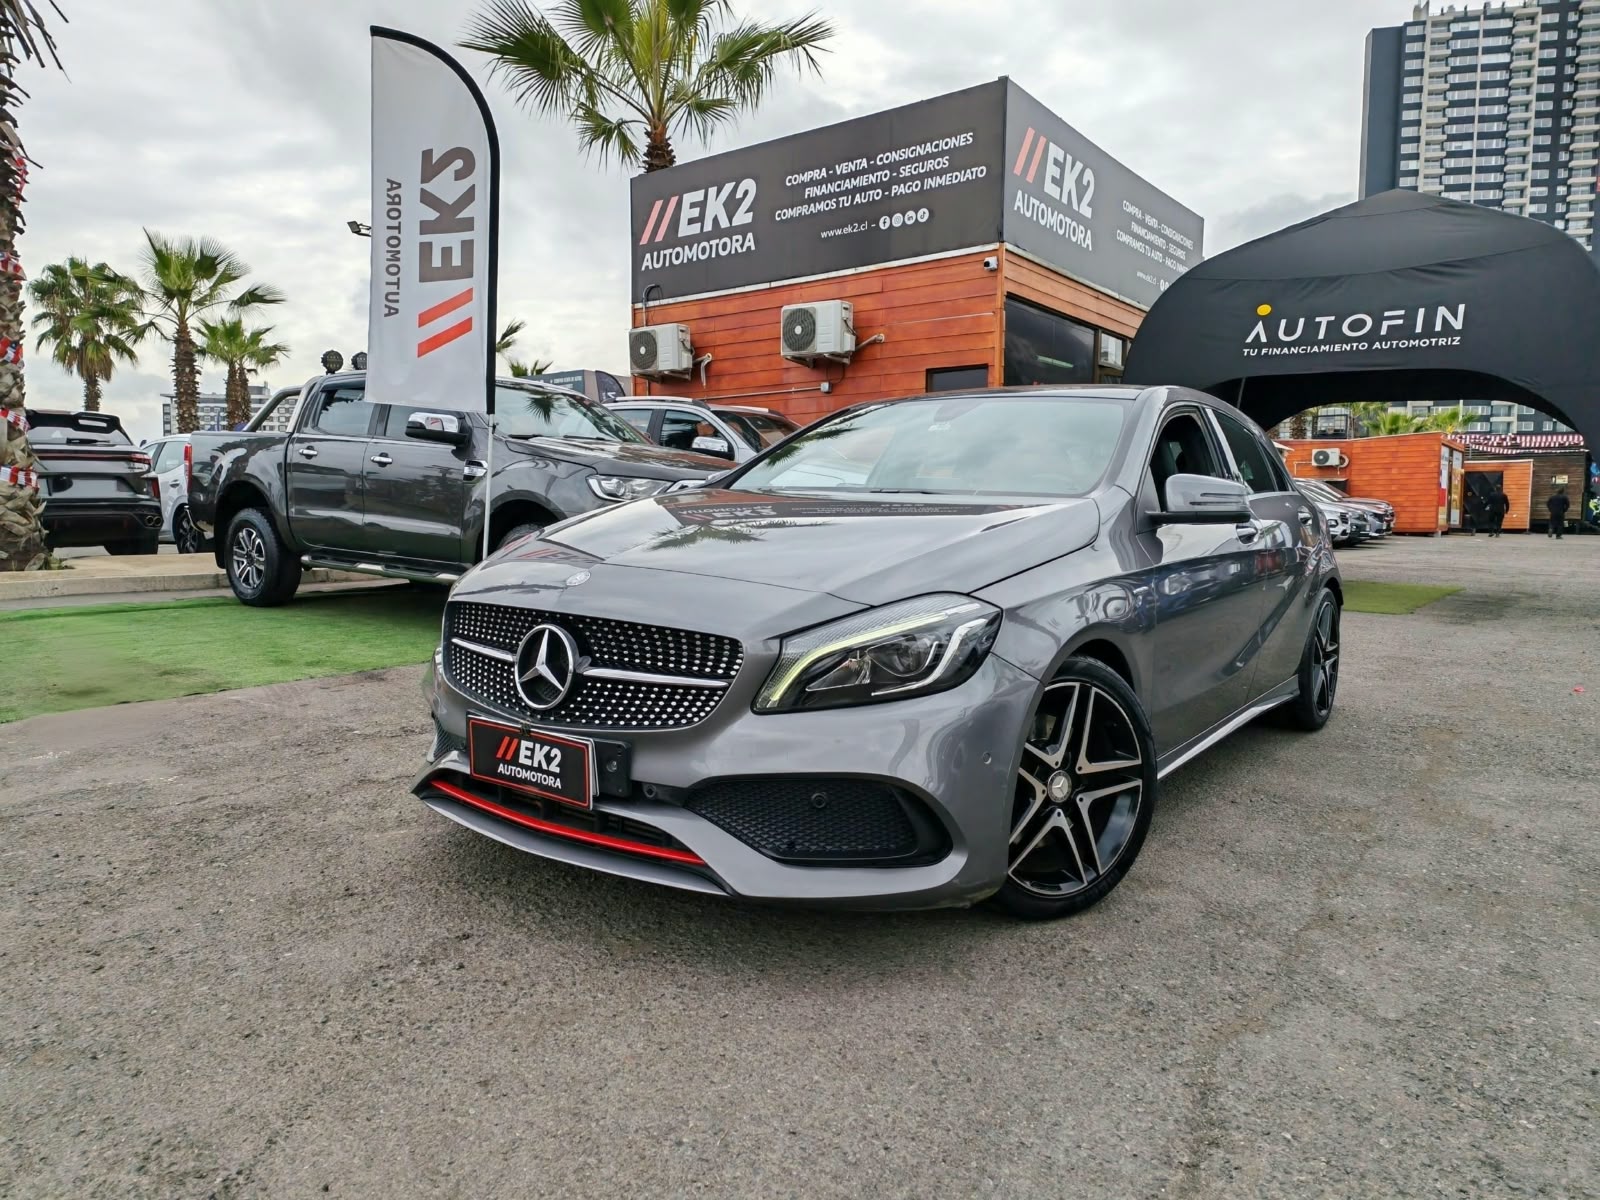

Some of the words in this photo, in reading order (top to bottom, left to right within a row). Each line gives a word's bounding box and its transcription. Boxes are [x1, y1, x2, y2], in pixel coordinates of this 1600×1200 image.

[785, 167, 827, 186] COMPRA
[835, 158, 868, 175] VENTA
[876, 132, 974, 166] CONSIGNACIONES
[804, 169, 890, 199] FINANCIAMIENTO
[899, 156, 950, 178] SEGUROS
[775, 198, 837, 221] COMPRAMOS
[838, 194, 852, 208] TU
[853, 188, 882, 205] AUTO
[891, 180, 921, 197] PAGO
[923, 165, 987, 190] INMEDIATO
[1043, 141, 1095, 219] EK2
[677, 178, 757, 238] EK2
[1013, 189, 1093, 251] AUTOMOTORA
[820, 221, 868, 239] www.ek2.cl
[641, 232, 756, 271] AUTOMOTORA
[1245, 304, 1466, 344] AUTOFIN
[1242, 348, 1259, 357] TU
[1261, 342, 1369, 356] FINANCIAMIENTO
[1372, 336, 1461, 350] AUTOMOTRIZ
[497, 763, 562, 790] AUTOMOTORA
[518, 739, 562, 774] EK2
